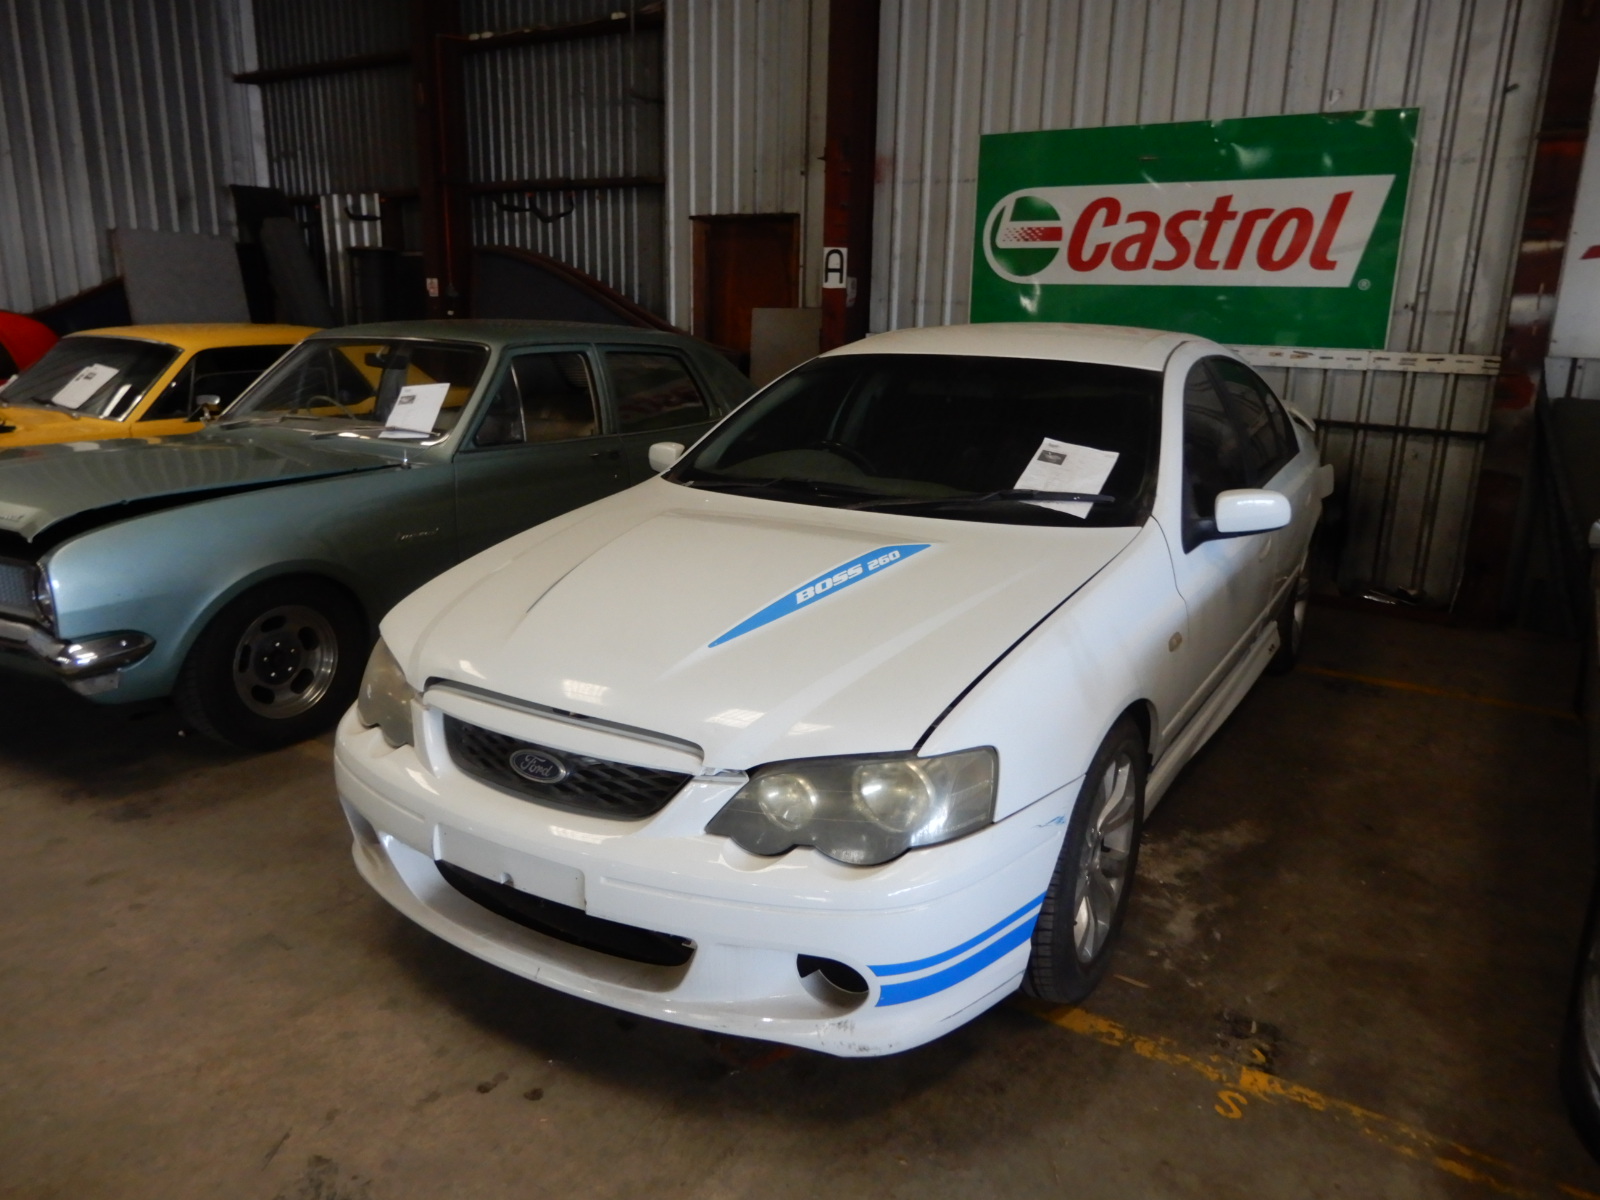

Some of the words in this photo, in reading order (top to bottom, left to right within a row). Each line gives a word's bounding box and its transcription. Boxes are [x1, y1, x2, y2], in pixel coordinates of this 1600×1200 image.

[1067, 190, 1354, 272] Castrol
[824, 249, 844, 284] A
[796, 563, 864, 605] BOSS
[867, 550, 901, 571] 260
[520, 754, 554, 776] Ford
